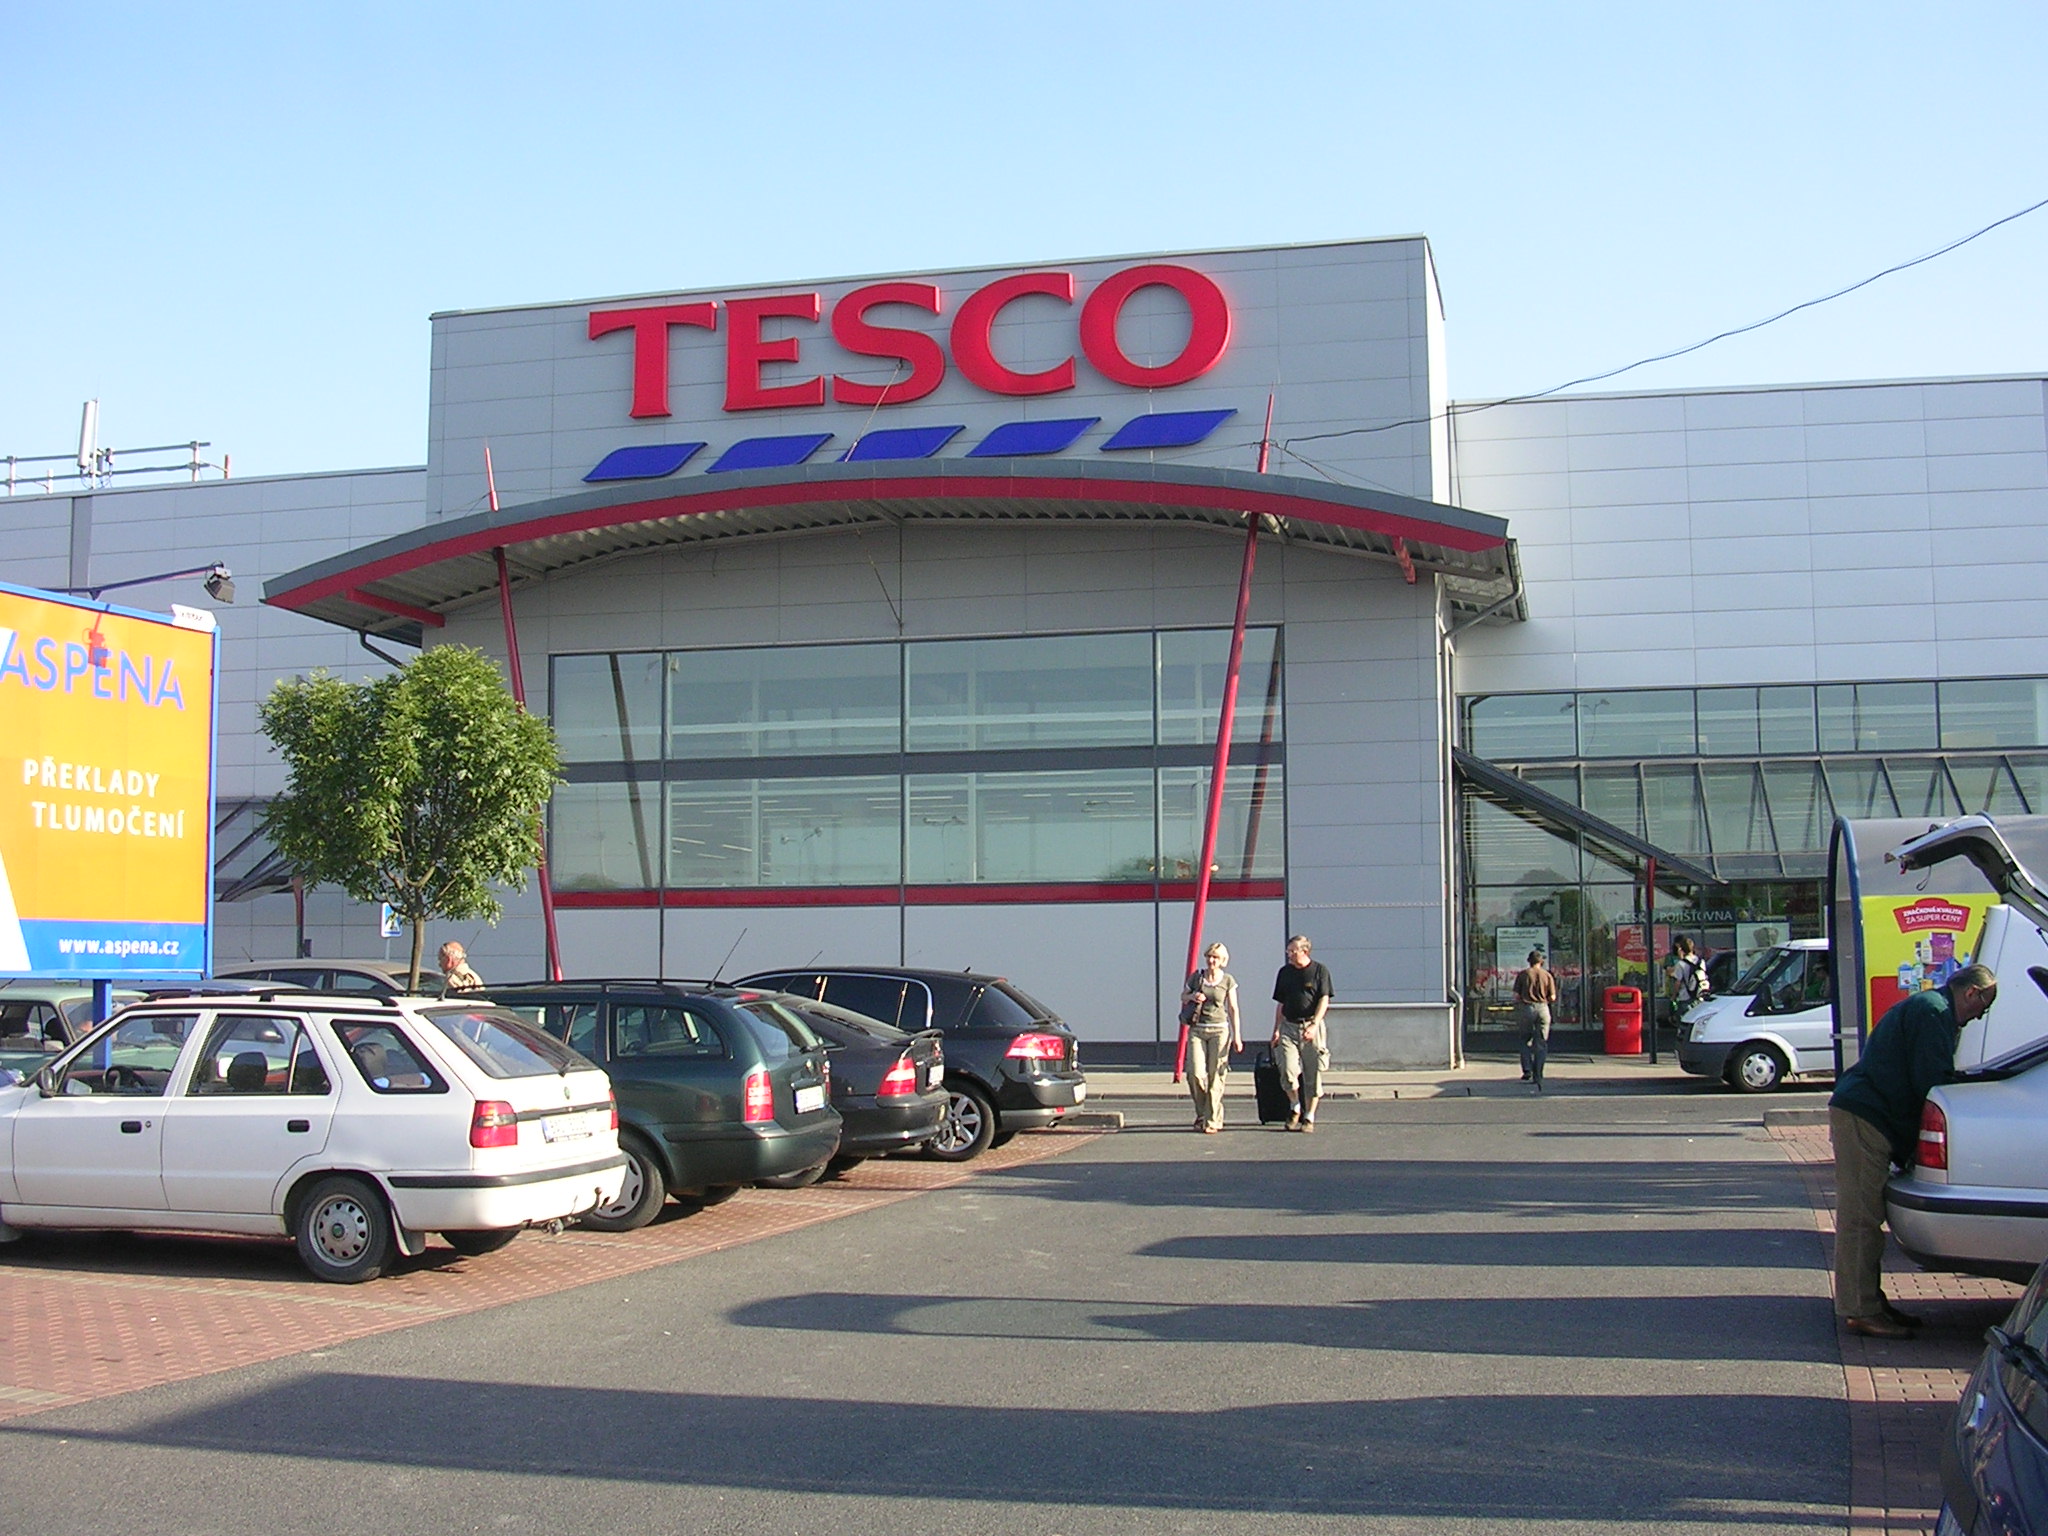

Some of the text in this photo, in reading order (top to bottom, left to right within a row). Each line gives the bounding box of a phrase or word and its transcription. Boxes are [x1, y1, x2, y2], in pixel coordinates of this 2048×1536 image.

[588, 263, 1232, 419] TESCO
[0, 630, 185, 711] ASPENA
[24, 756, 160, 798] PŘEKLADY
[32, 801, 185, 839] TLUMOČENÍ
[1916, 914, 1940, 923] SUPER
[1941, 914, 1962, 923] CENY
[59, 938, 180, 958] www.aspena.cz
